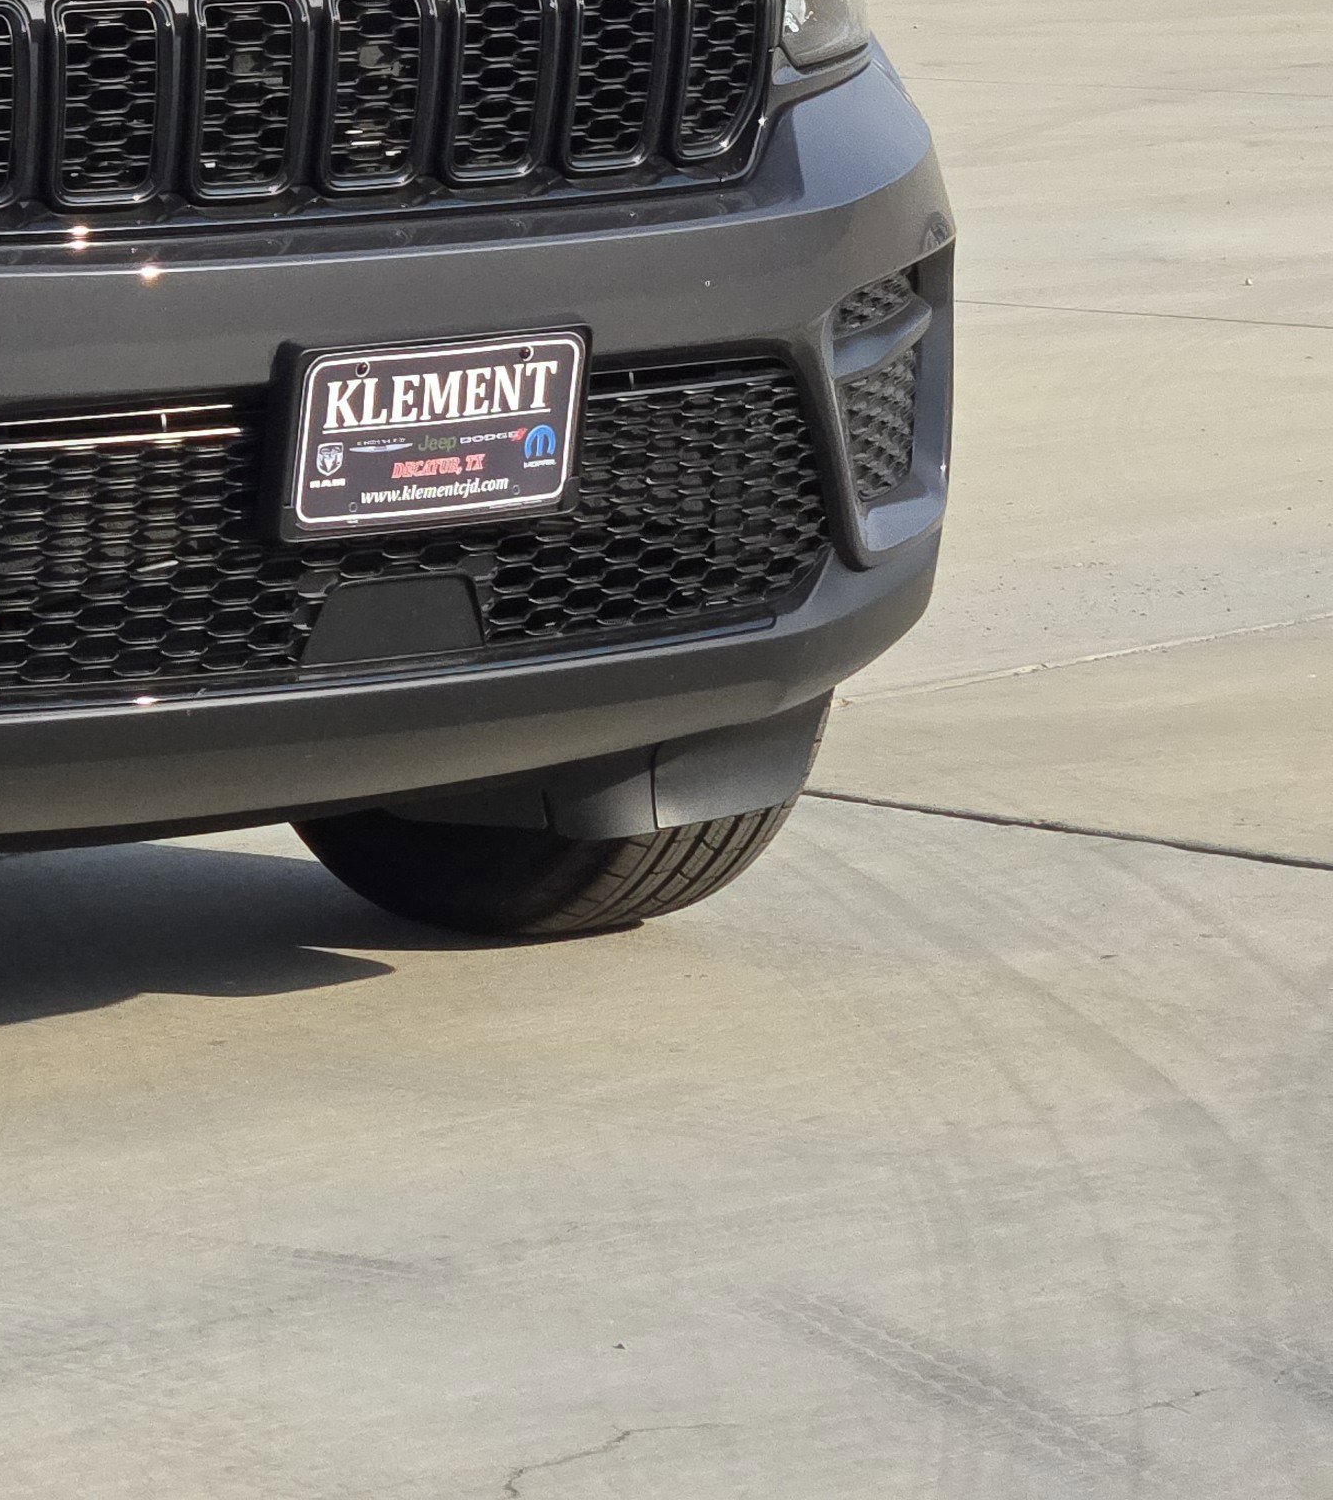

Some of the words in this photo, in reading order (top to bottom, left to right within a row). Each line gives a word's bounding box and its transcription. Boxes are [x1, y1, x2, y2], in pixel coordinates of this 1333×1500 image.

[322, 360, 559, 430] KLEMENT
[417, 434, 458, 452] Jeep
[465, 453, 486, 472] TX
[360, 476, 510, 505] www.klementcjd.com
